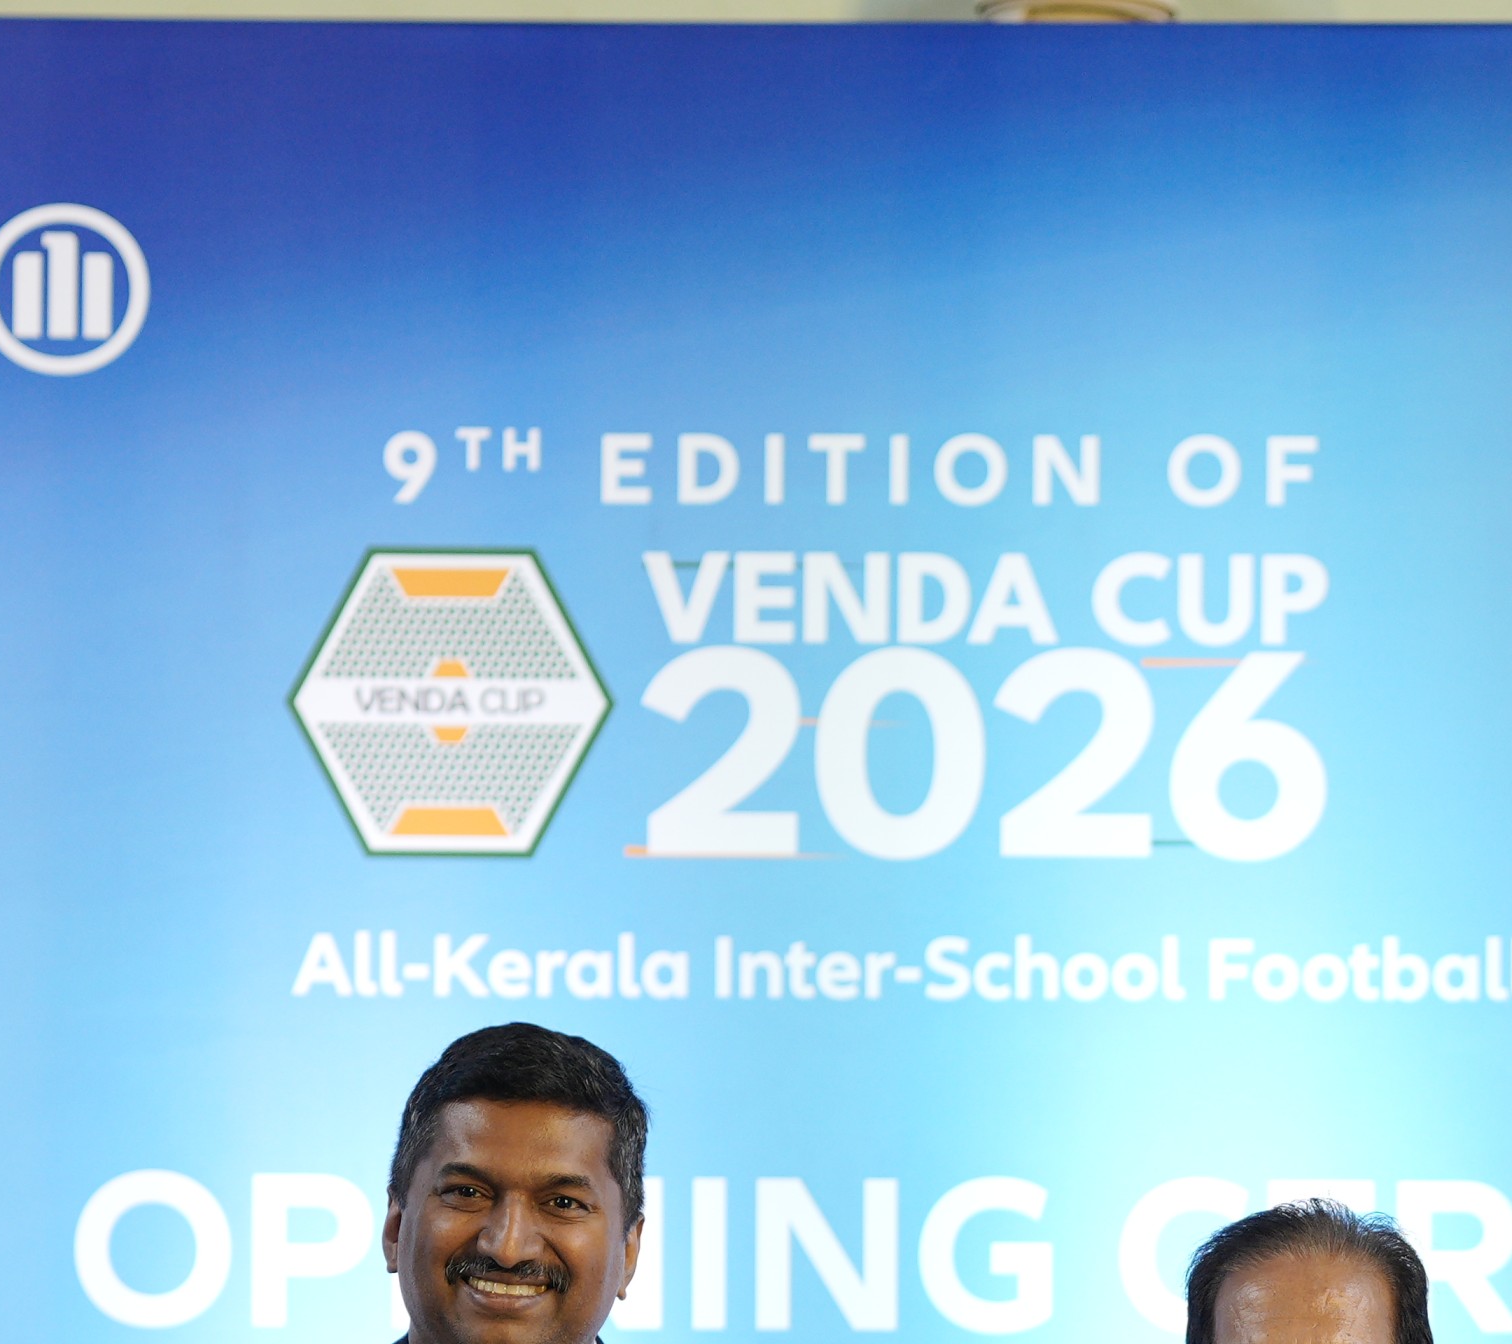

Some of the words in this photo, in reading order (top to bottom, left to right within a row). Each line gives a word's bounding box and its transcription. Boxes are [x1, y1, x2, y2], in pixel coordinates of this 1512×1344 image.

[600, 432, 1101, 507] EDITION
[1166, 434, 1320, 507] OF
[641, 549, 1059, 647] VENDA
[1090, 551, 1331, 647] CUP
[355, 686, 471, 714] VENDA
[479, 686, 547, 714] CUP
[639, 646, 1330, 862] 2026
[291, 931, 690, 1000] All-Kerala
[714, 934, 1181, 1002] Inter-School
[73, 1168, 1054, 1334] OPING
